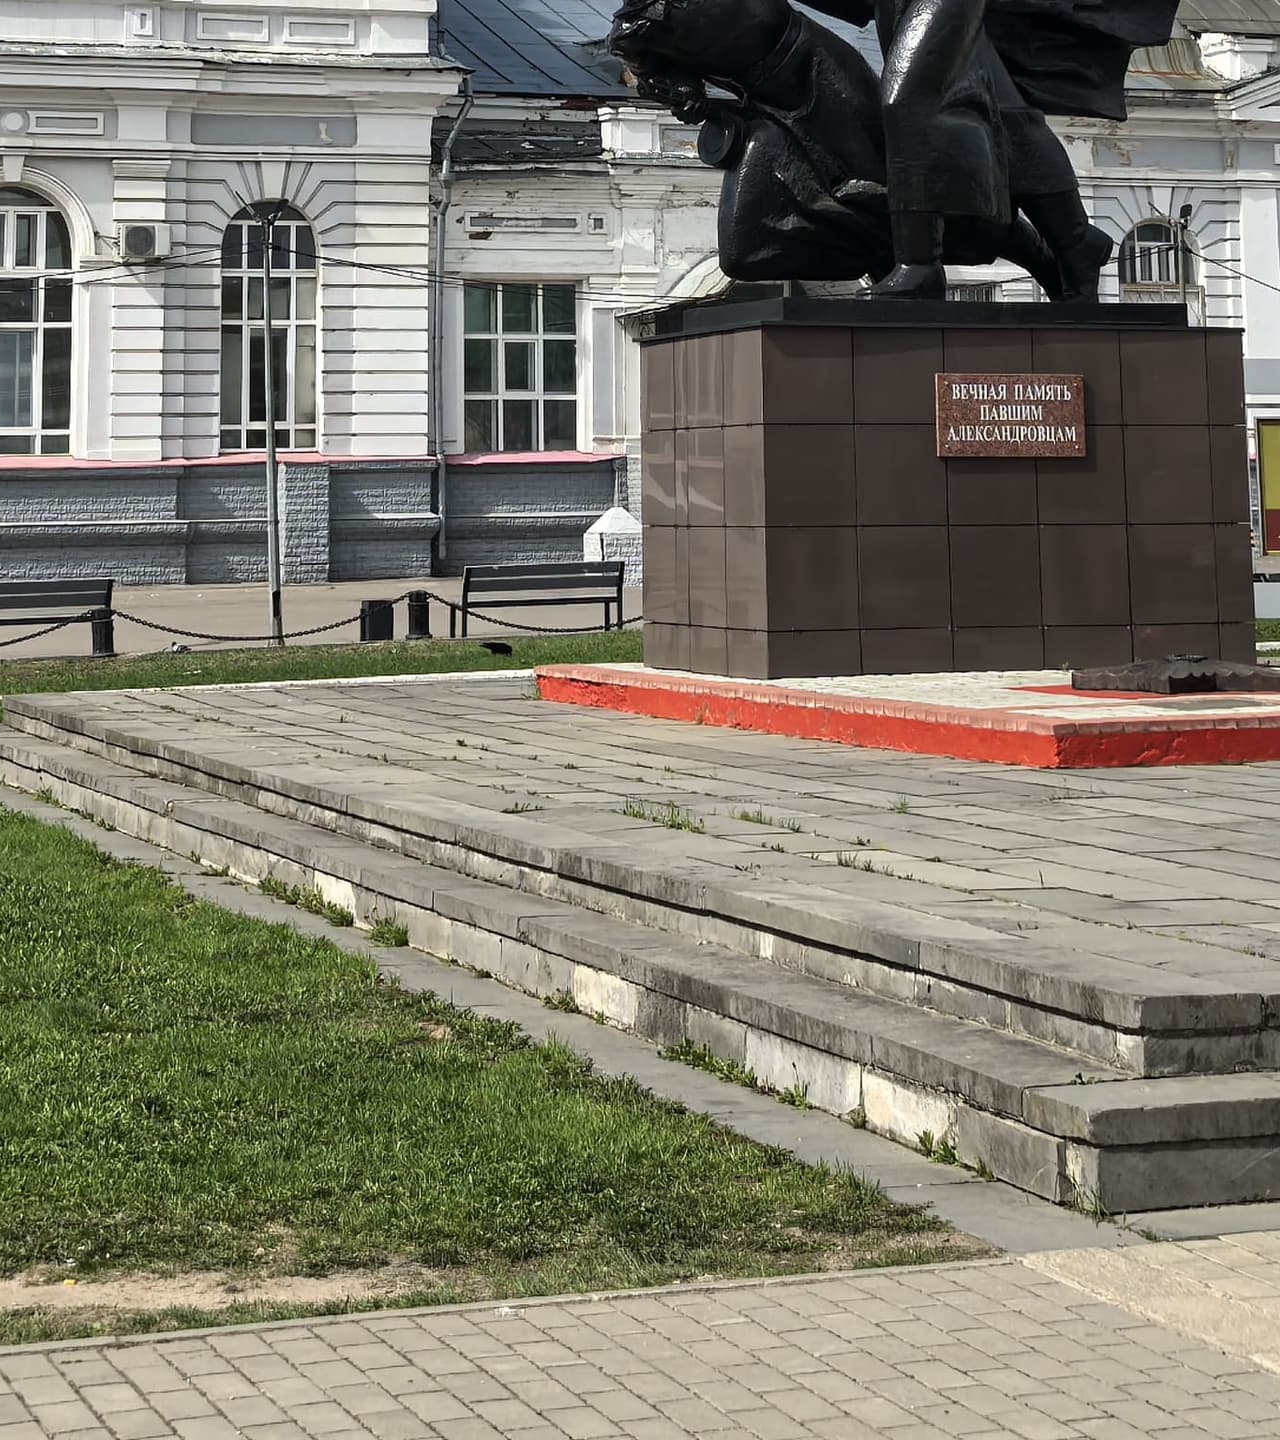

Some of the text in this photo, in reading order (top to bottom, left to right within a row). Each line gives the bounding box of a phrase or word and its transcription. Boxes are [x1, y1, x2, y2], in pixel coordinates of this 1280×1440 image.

[951, 383, 1072, 401] ВЕЧНАЯ ПАМЯТЬ
[979, 403, 1044, 422] ПАВШИМ
[946, 423, 1078, 445] АЛЕКСАНДРОВЦАМ
